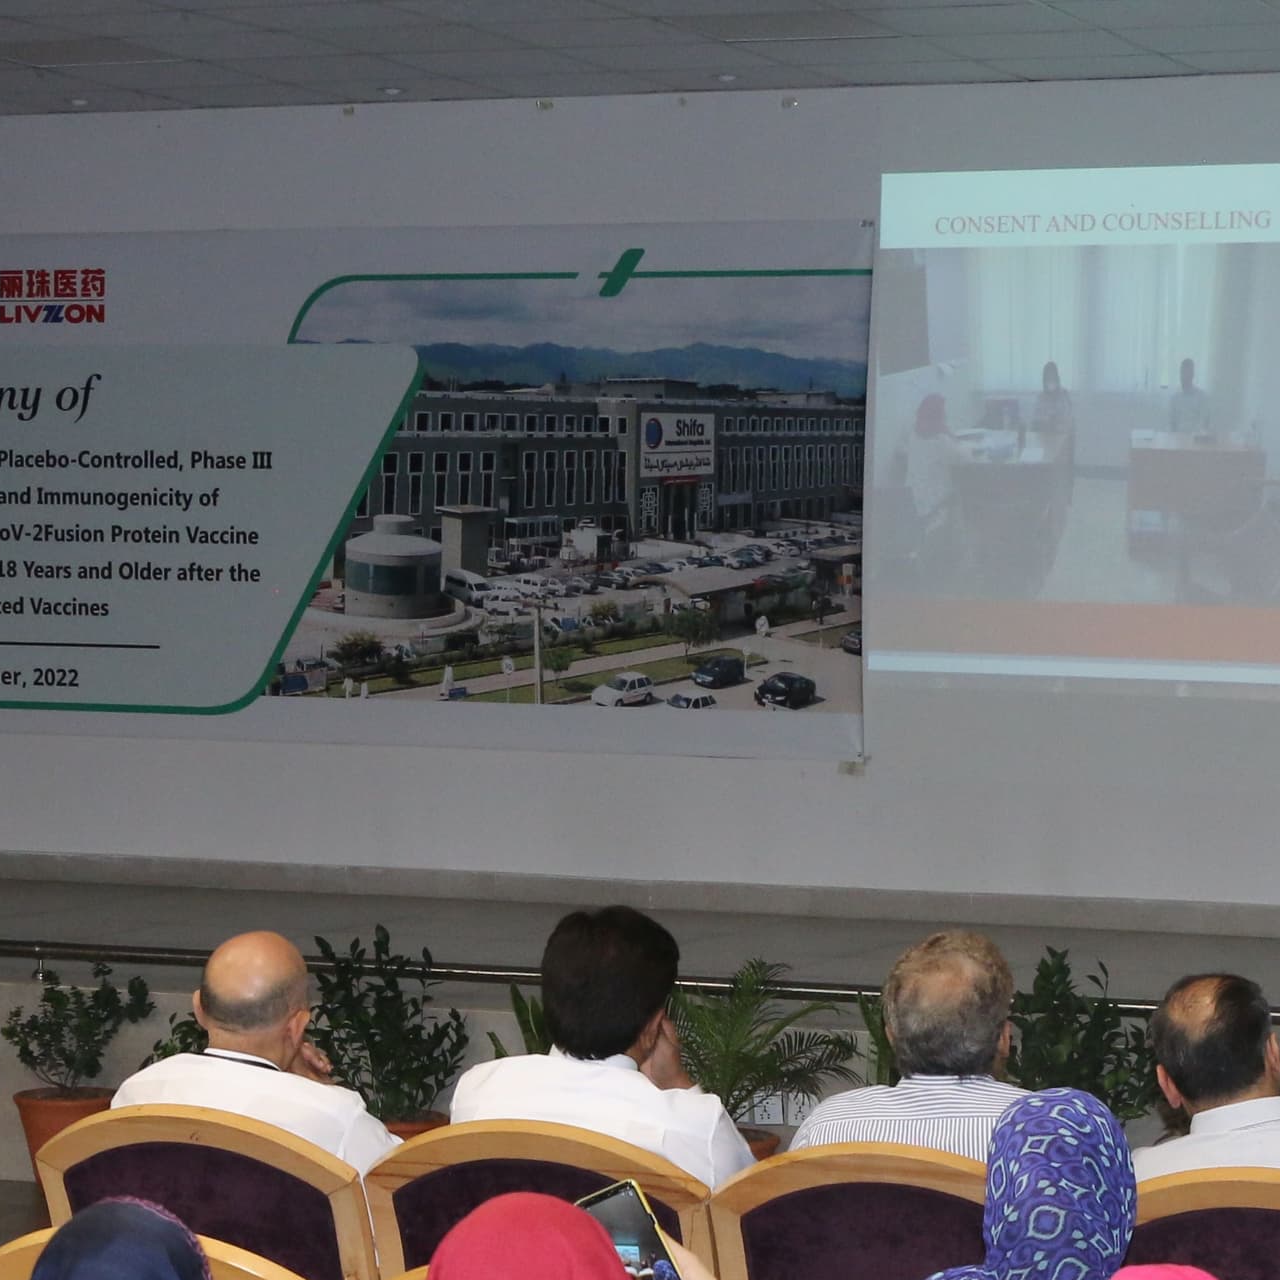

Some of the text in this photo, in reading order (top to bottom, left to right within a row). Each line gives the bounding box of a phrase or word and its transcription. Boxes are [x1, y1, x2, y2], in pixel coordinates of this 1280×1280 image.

[934, 209, 1272, 235] CONSENT AND COUNSELLING
[55, 373, 103, 424] of
[675, 418, 705, 438] Shifa
[190, 449, 247, 470] Phase
[251, 450, 273, 470] III
[36, 486, 194, 512] Immunogenicity
[198, 487, 220, 507] of
[111, 524, 181, 544] Protein
[185, 525, 260, 545] Vaccine
[22, 560, 72, 580] Years
[76, 560, 113, 580] and
[118, 561, 173, 582] Older
[176, 561, 224, 582] after
[228, 562, 261, 583] the
[29, 596, 110, 617] Vaccines
[32, 667, 80, 688] 2022
